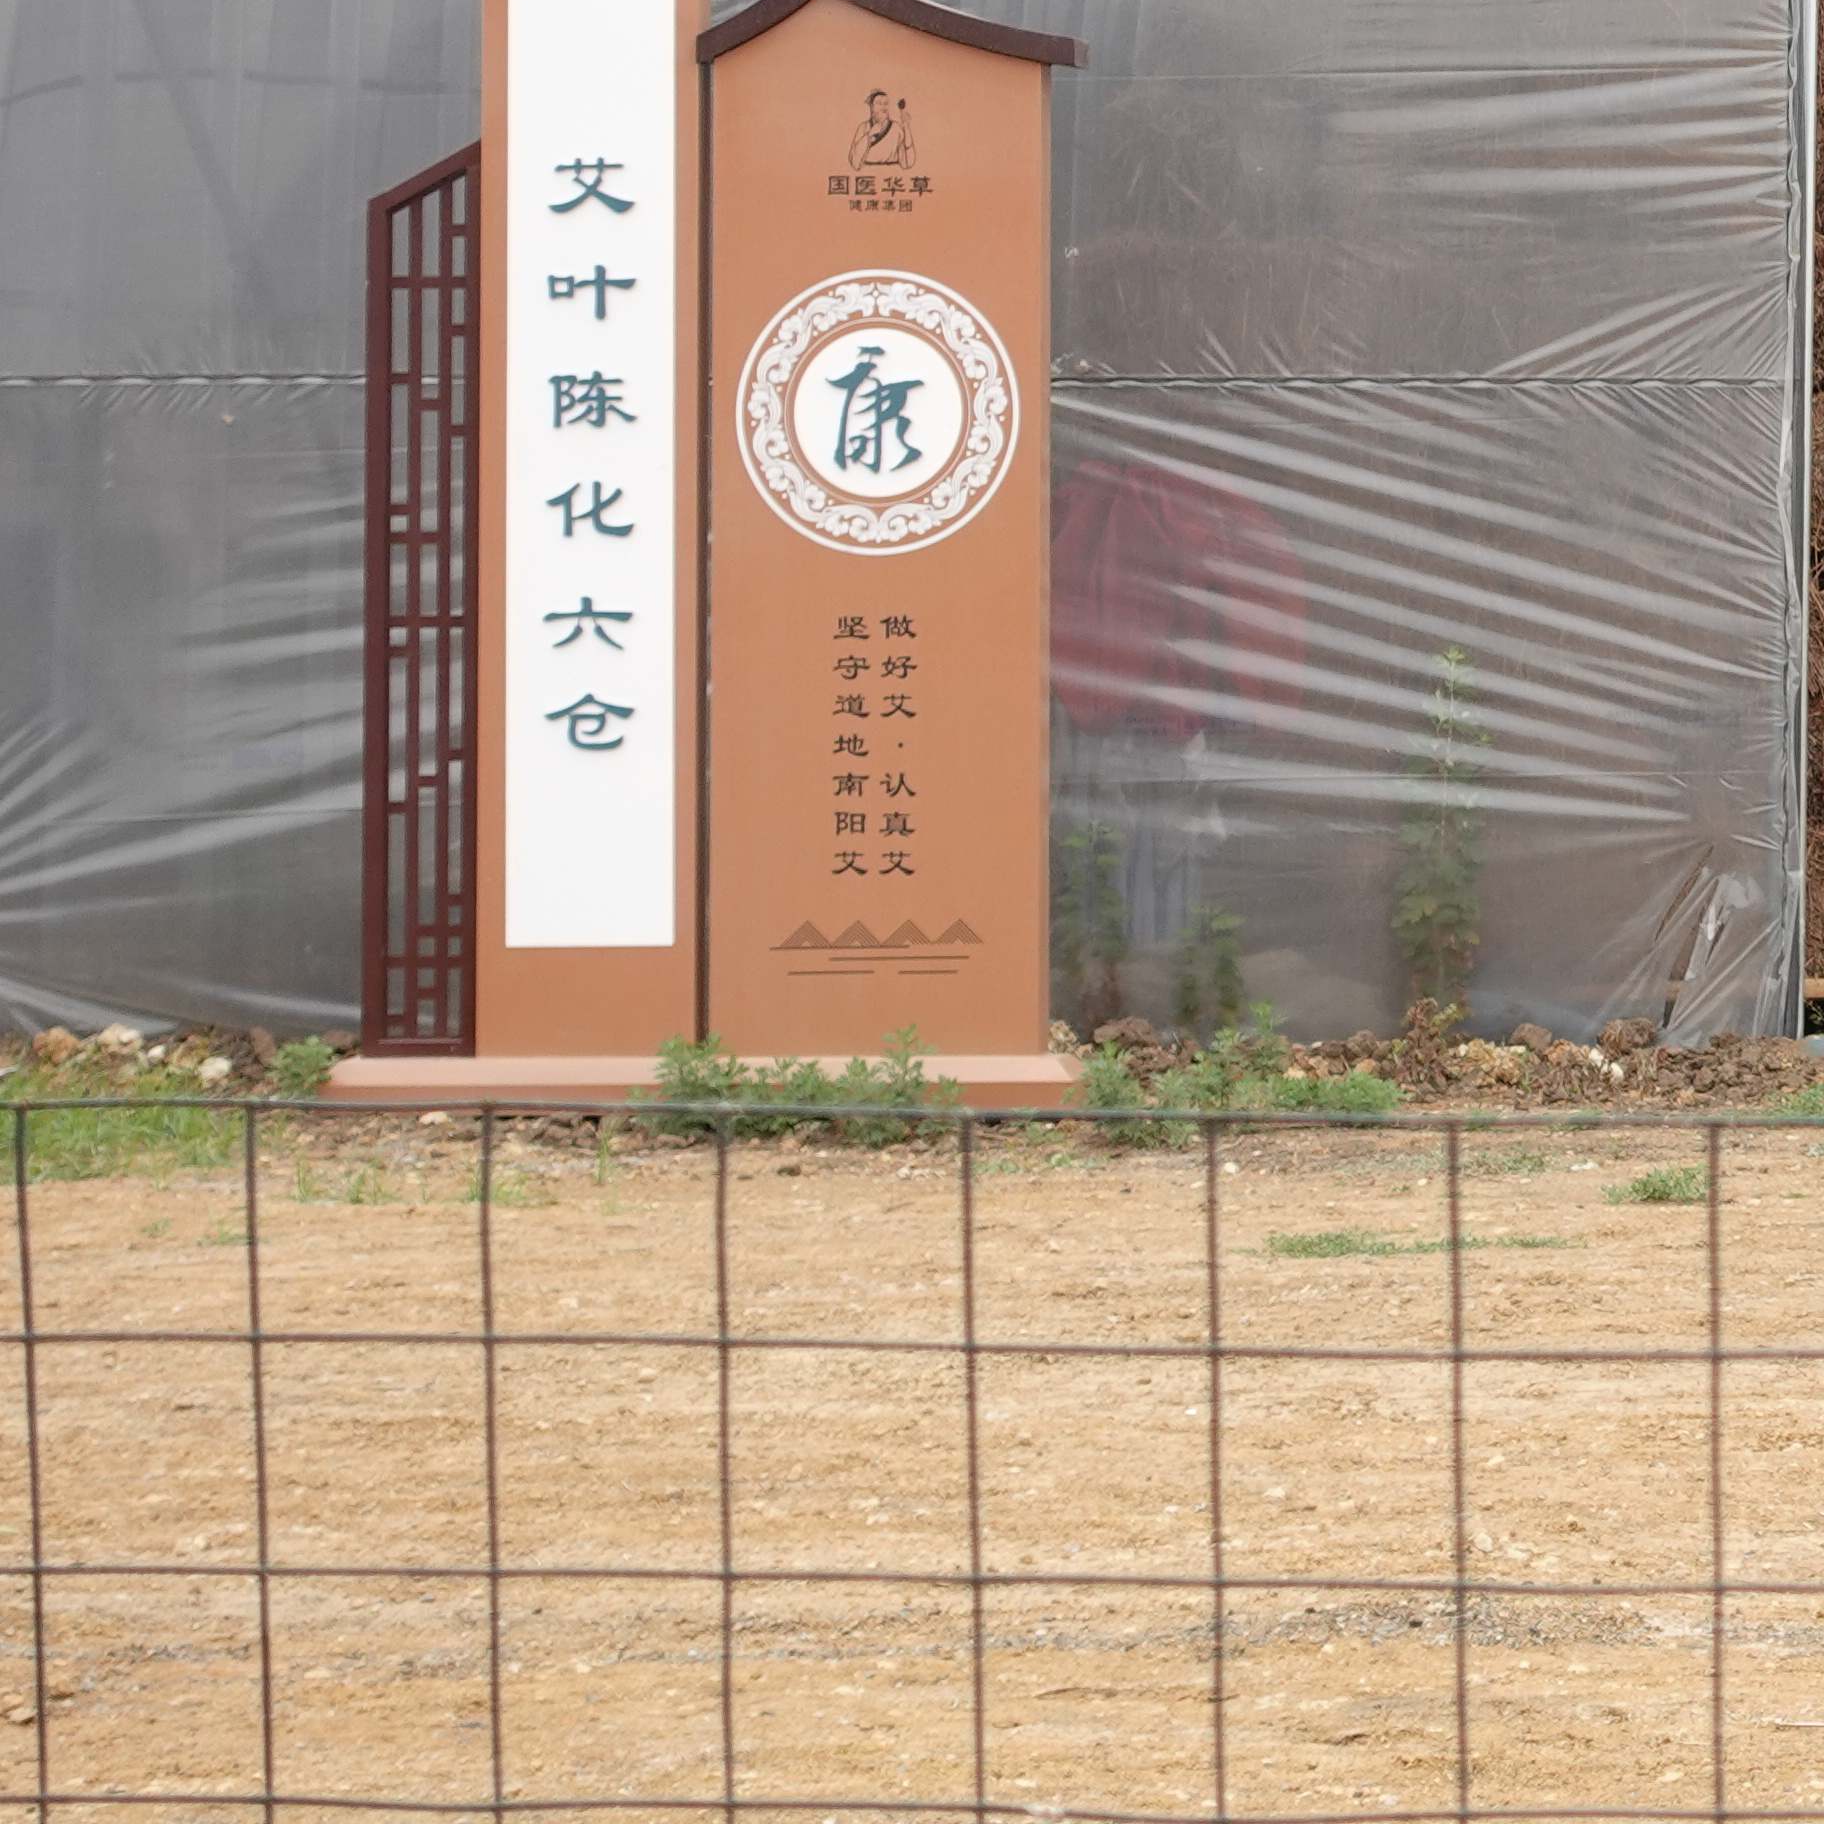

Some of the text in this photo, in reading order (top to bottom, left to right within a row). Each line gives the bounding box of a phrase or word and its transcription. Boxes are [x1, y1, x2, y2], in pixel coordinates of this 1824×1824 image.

[827, 176, 933, 197] 国医华草
[848, 199, 913, 212] 健康集团
[545, 156, 638, 753] 艾叶陈化六仓
[832, 615, 871, 875] 坚守道地南阳艾
